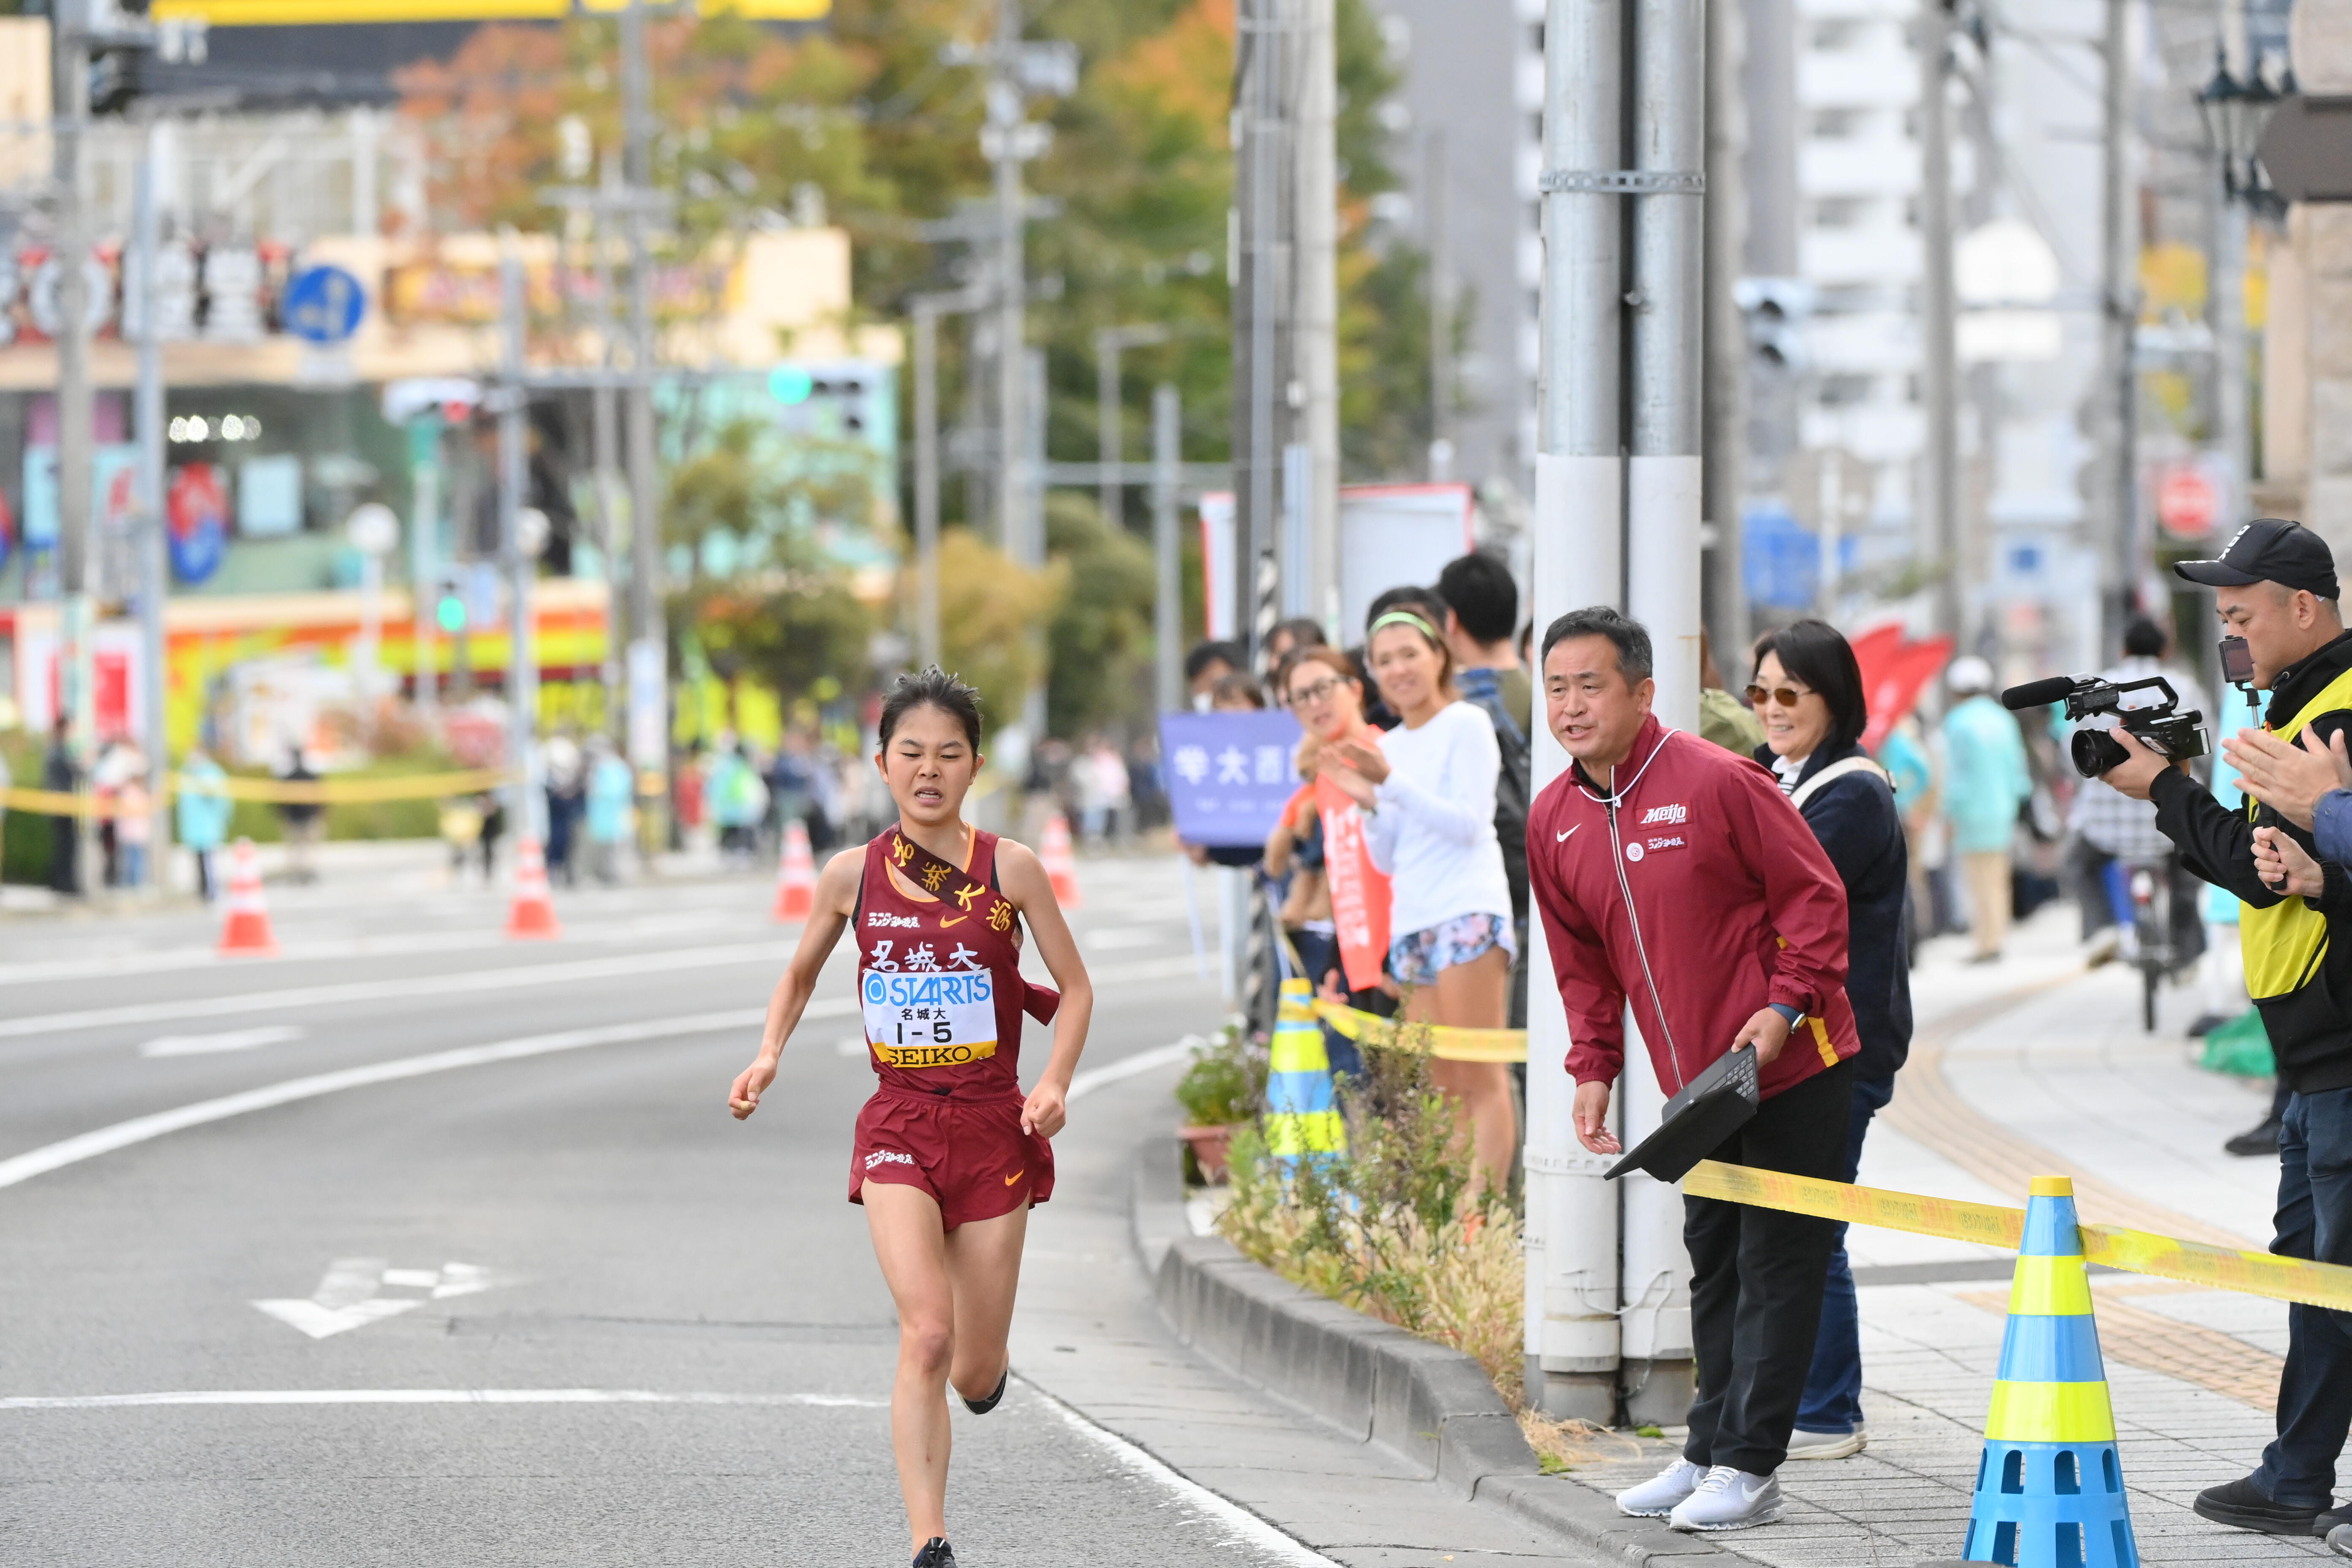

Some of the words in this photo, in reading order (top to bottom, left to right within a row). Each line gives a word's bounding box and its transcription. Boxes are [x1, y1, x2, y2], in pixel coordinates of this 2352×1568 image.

[1640, 803, 1686, 824] Meijo
[892, 833, 1011, 931] 名城大学
[870, 940, 983, 972] 名城大
[901, 1007, 946, 1021] 名城大
[897, 1021, 952, 1044] 1-5
[887, 1046, 972, 1064] SEIKO
